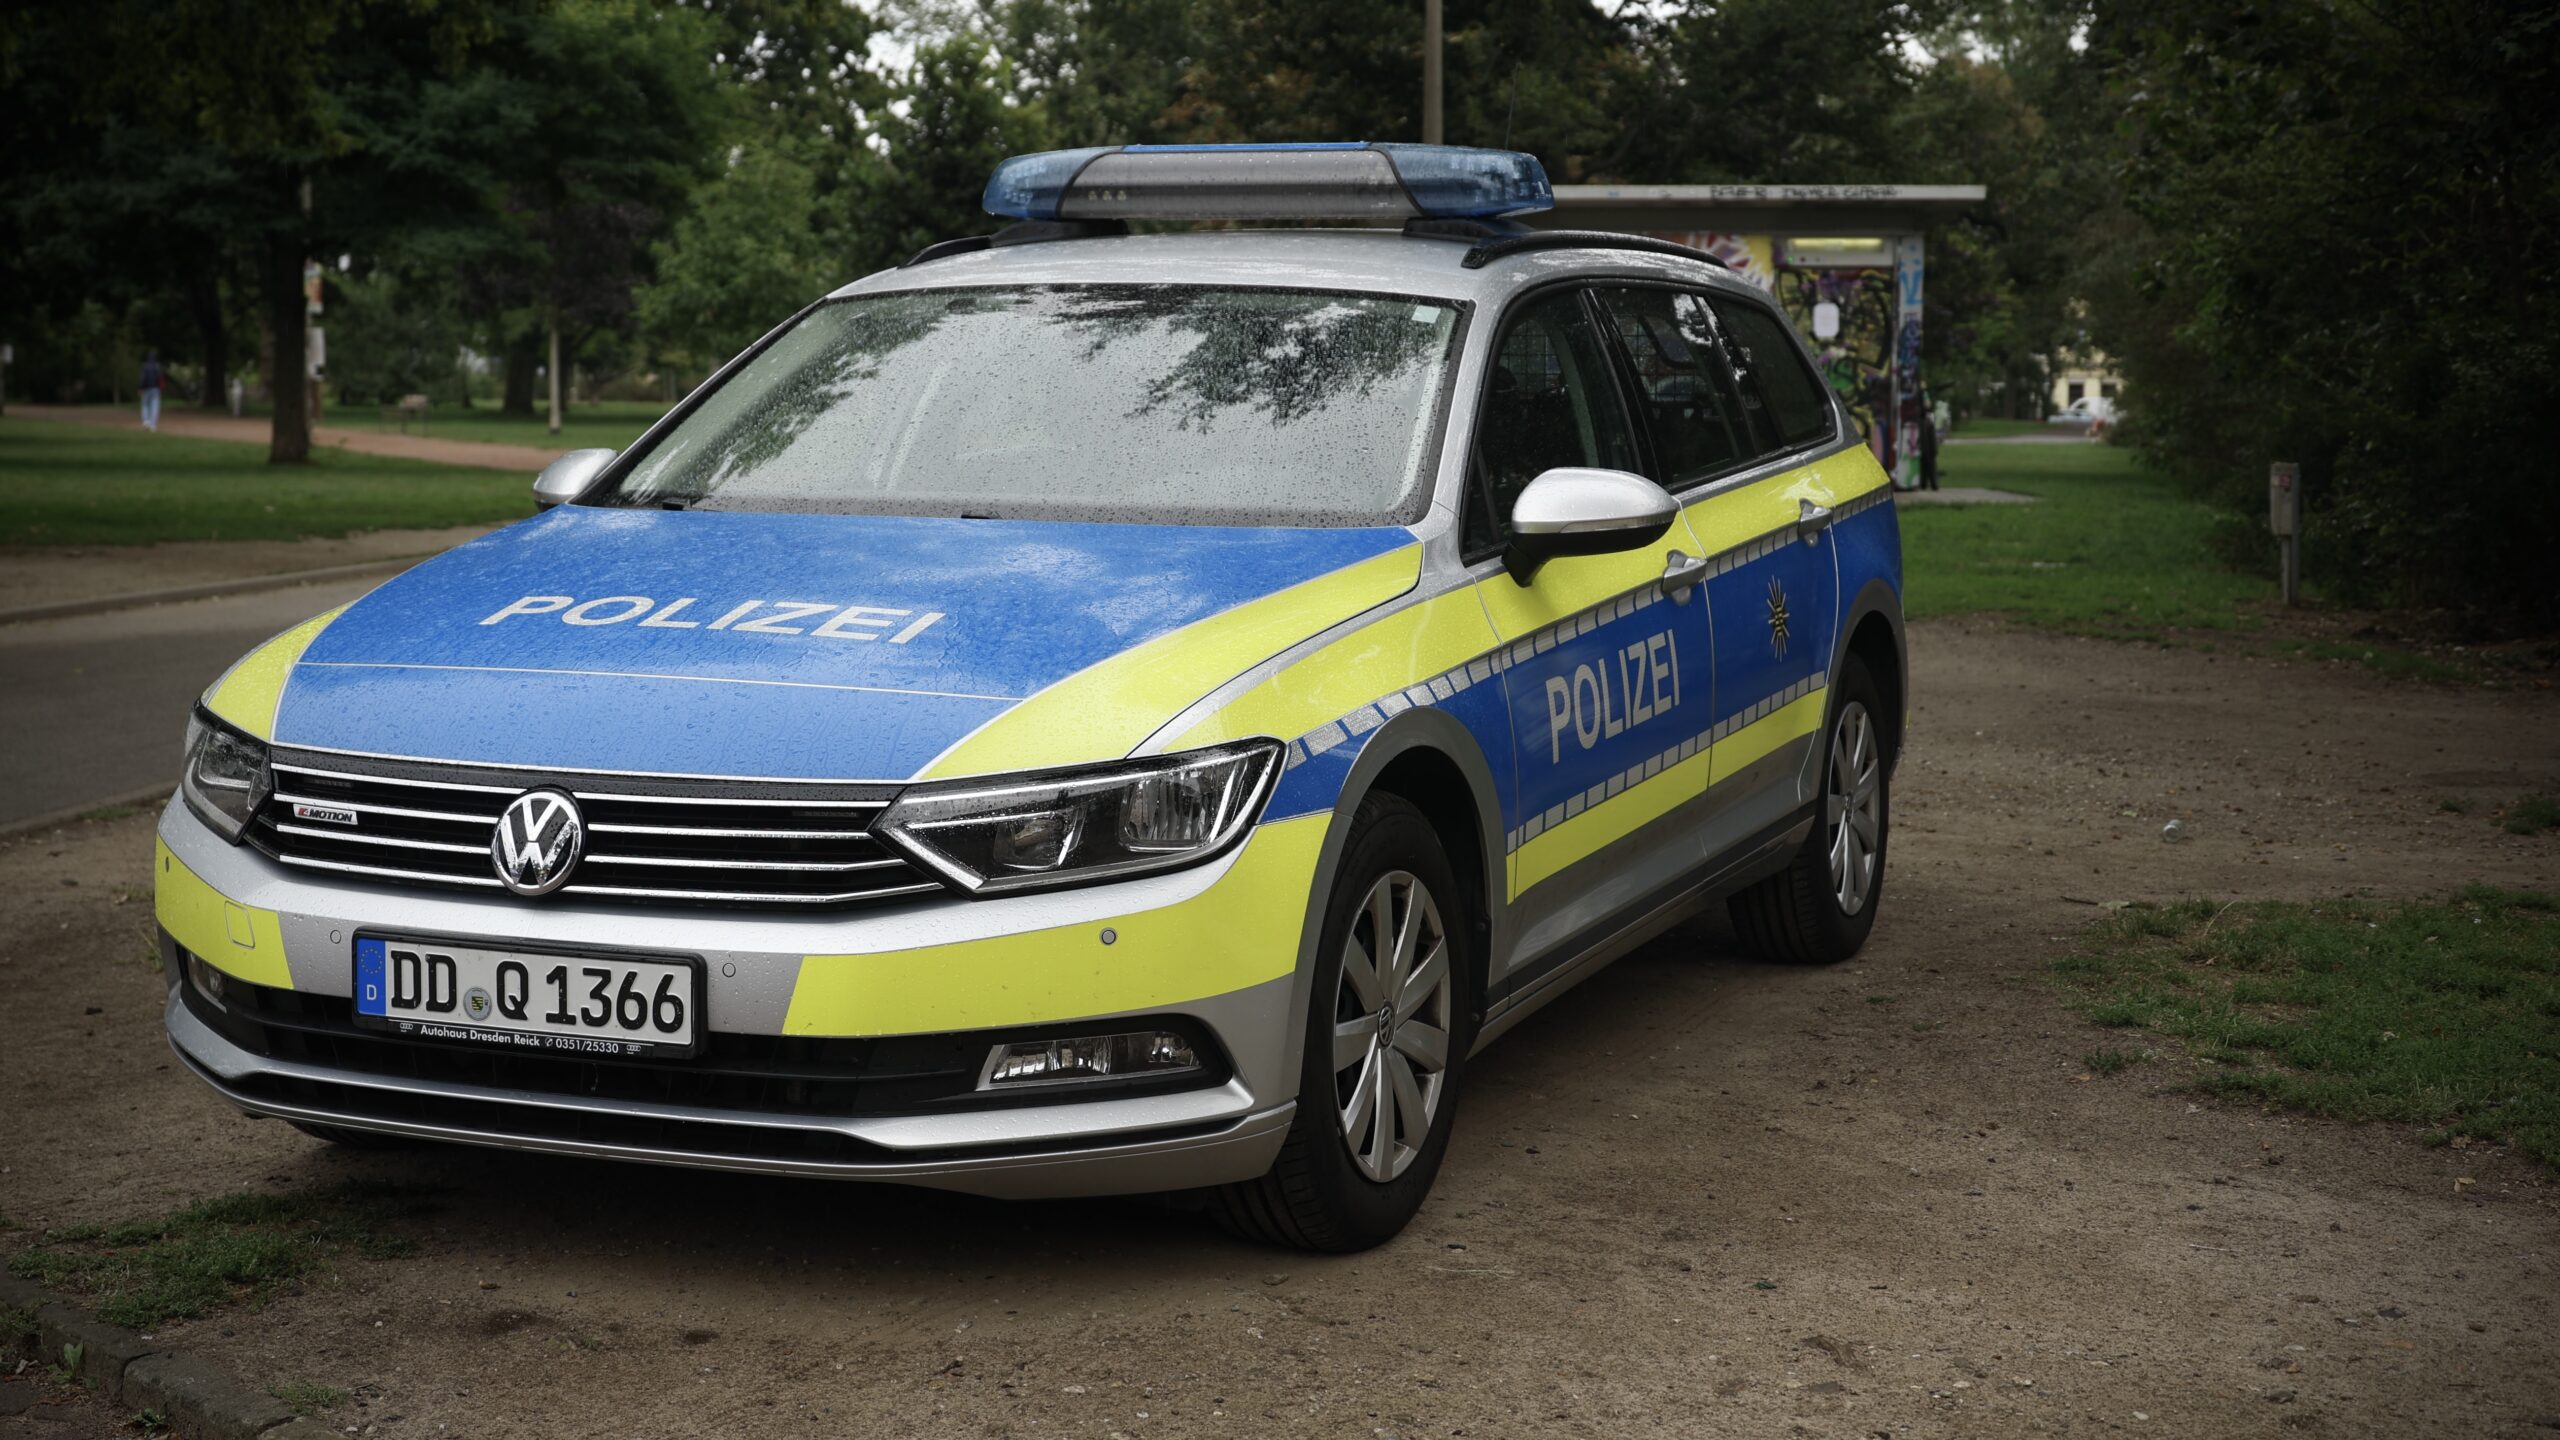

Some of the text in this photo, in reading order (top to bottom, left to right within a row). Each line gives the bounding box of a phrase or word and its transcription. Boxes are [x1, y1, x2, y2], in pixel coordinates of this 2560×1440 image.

[479, 595, 946, 644] POLIZEI
[1545, 629, 1680, 765] POLIZEI
[491, 790, 583, 896] VW
[366, 984, 377, 1000] D
[390, 950, 685, 1034] DD Q 1366
[420, 1024, 619, 1054] Autohaus Dresden Reick 0351/25330
